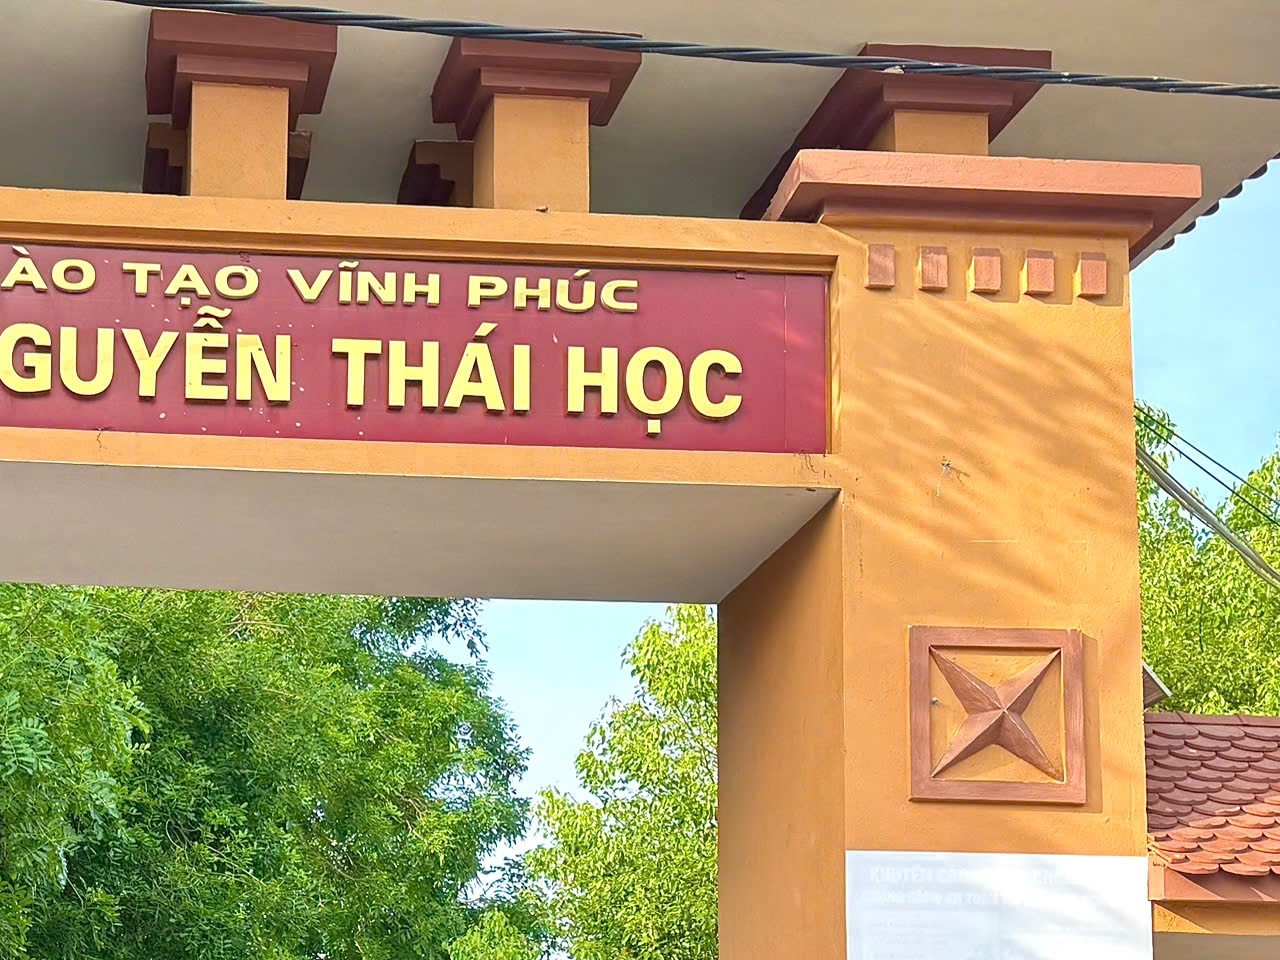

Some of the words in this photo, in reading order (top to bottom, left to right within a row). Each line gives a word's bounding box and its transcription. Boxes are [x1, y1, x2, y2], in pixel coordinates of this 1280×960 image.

[122, 261, 260, 310] TẠO
[289, 260, 442, 307] VĨNH
[467, 268, 640, 315] PHÚC
[331, 322, 533, 415] THÁI
[566, 345, 745, 435] HỌC
